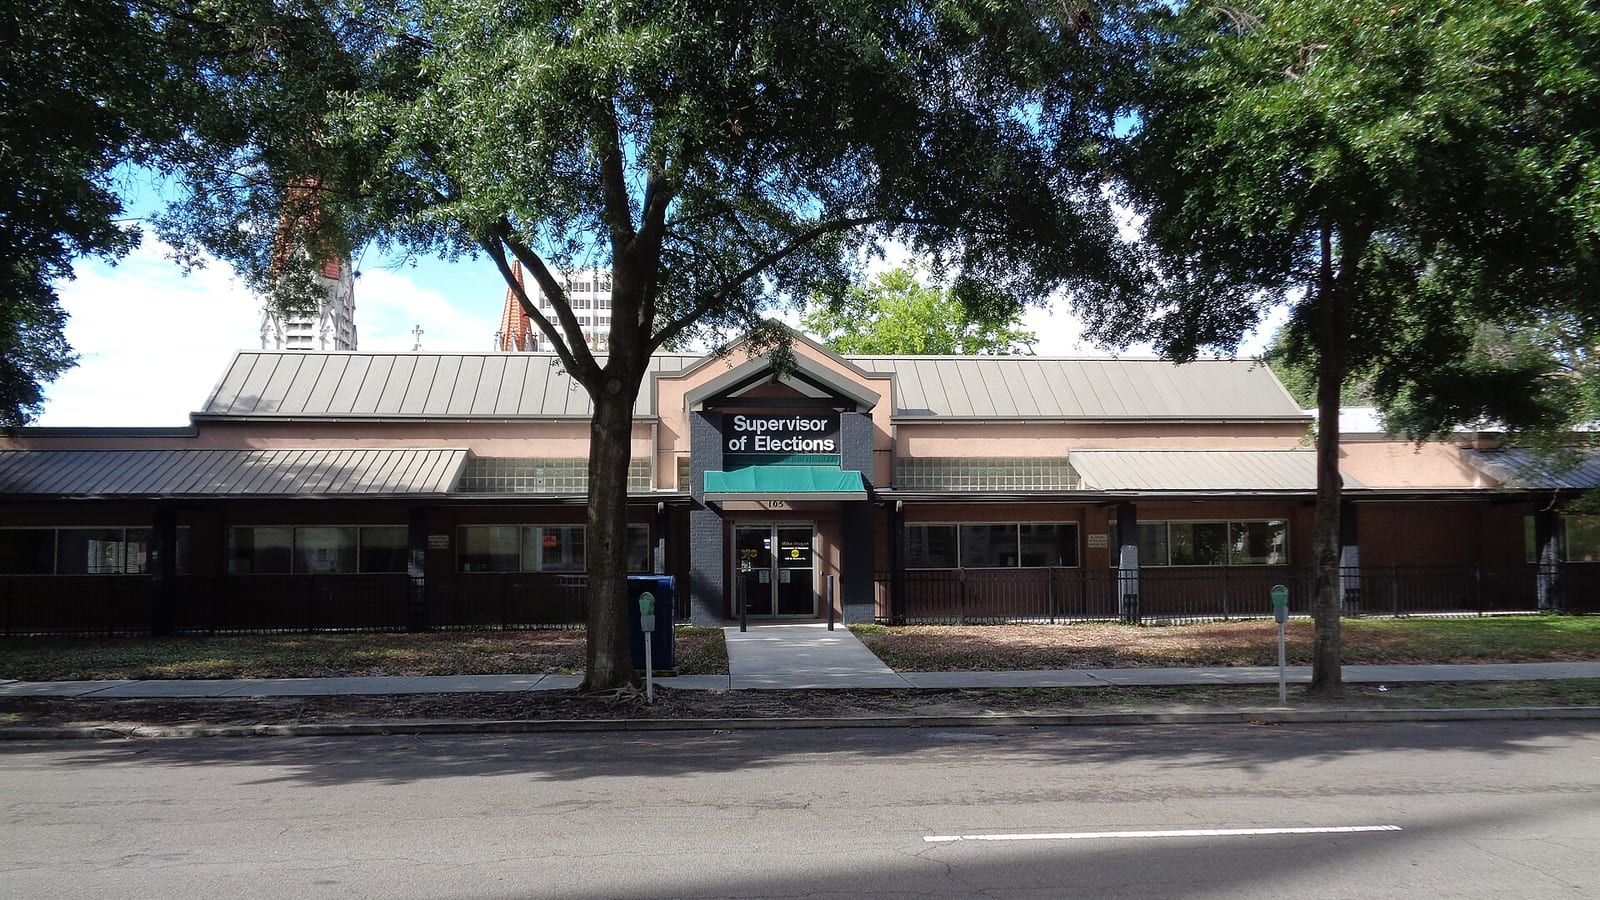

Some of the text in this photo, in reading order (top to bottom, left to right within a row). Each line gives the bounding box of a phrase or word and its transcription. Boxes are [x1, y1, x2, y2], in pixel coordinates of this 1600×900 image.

[733, 415, 828, 435] Supervisor
[728, 435, 835, 451] of Elections
